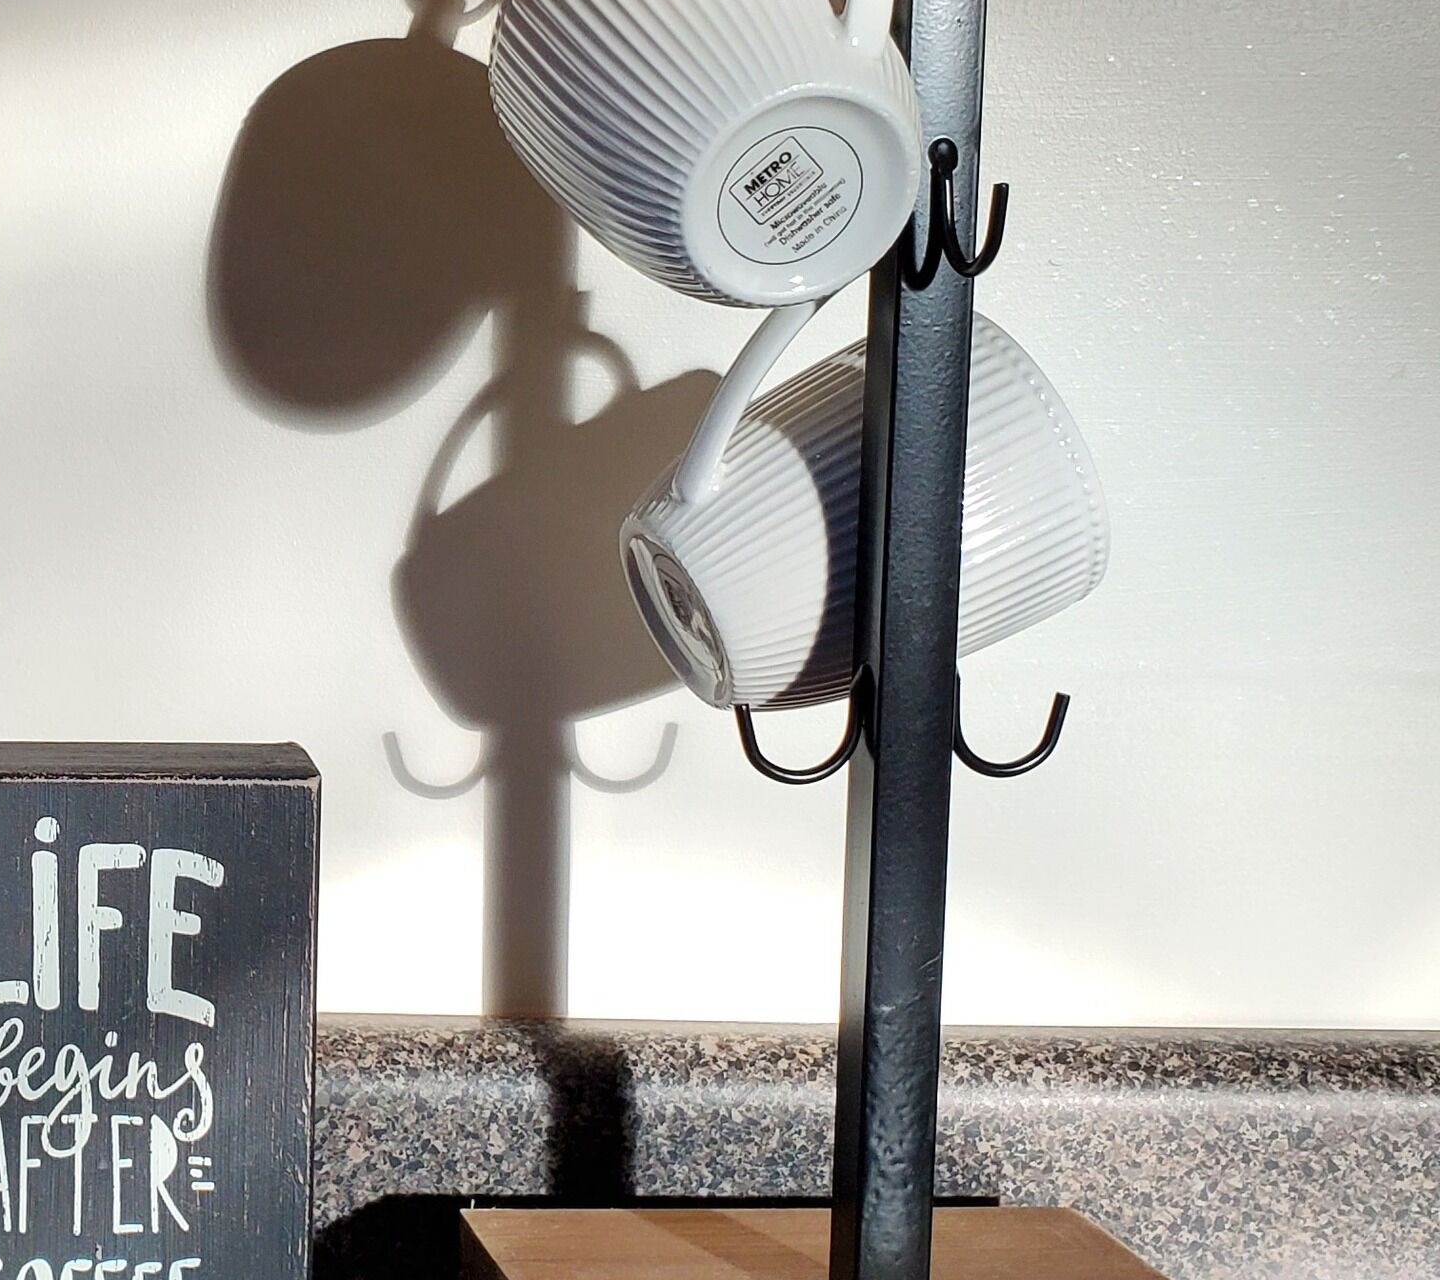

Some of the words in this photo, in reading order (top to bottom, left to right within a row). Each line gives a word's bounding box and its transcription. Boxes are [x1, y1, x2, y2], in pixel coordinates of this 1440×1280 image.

[743, 151, 792, 195] METRO
[753, 161, 805, 207] HOME
[778, 207, 824, 246] Dishwasher
[823, 193, 842, 209] safe
[791, 233, 815, 254] Made
[814, 224, 824, 235] in
[822, 206, 848, 227] China
